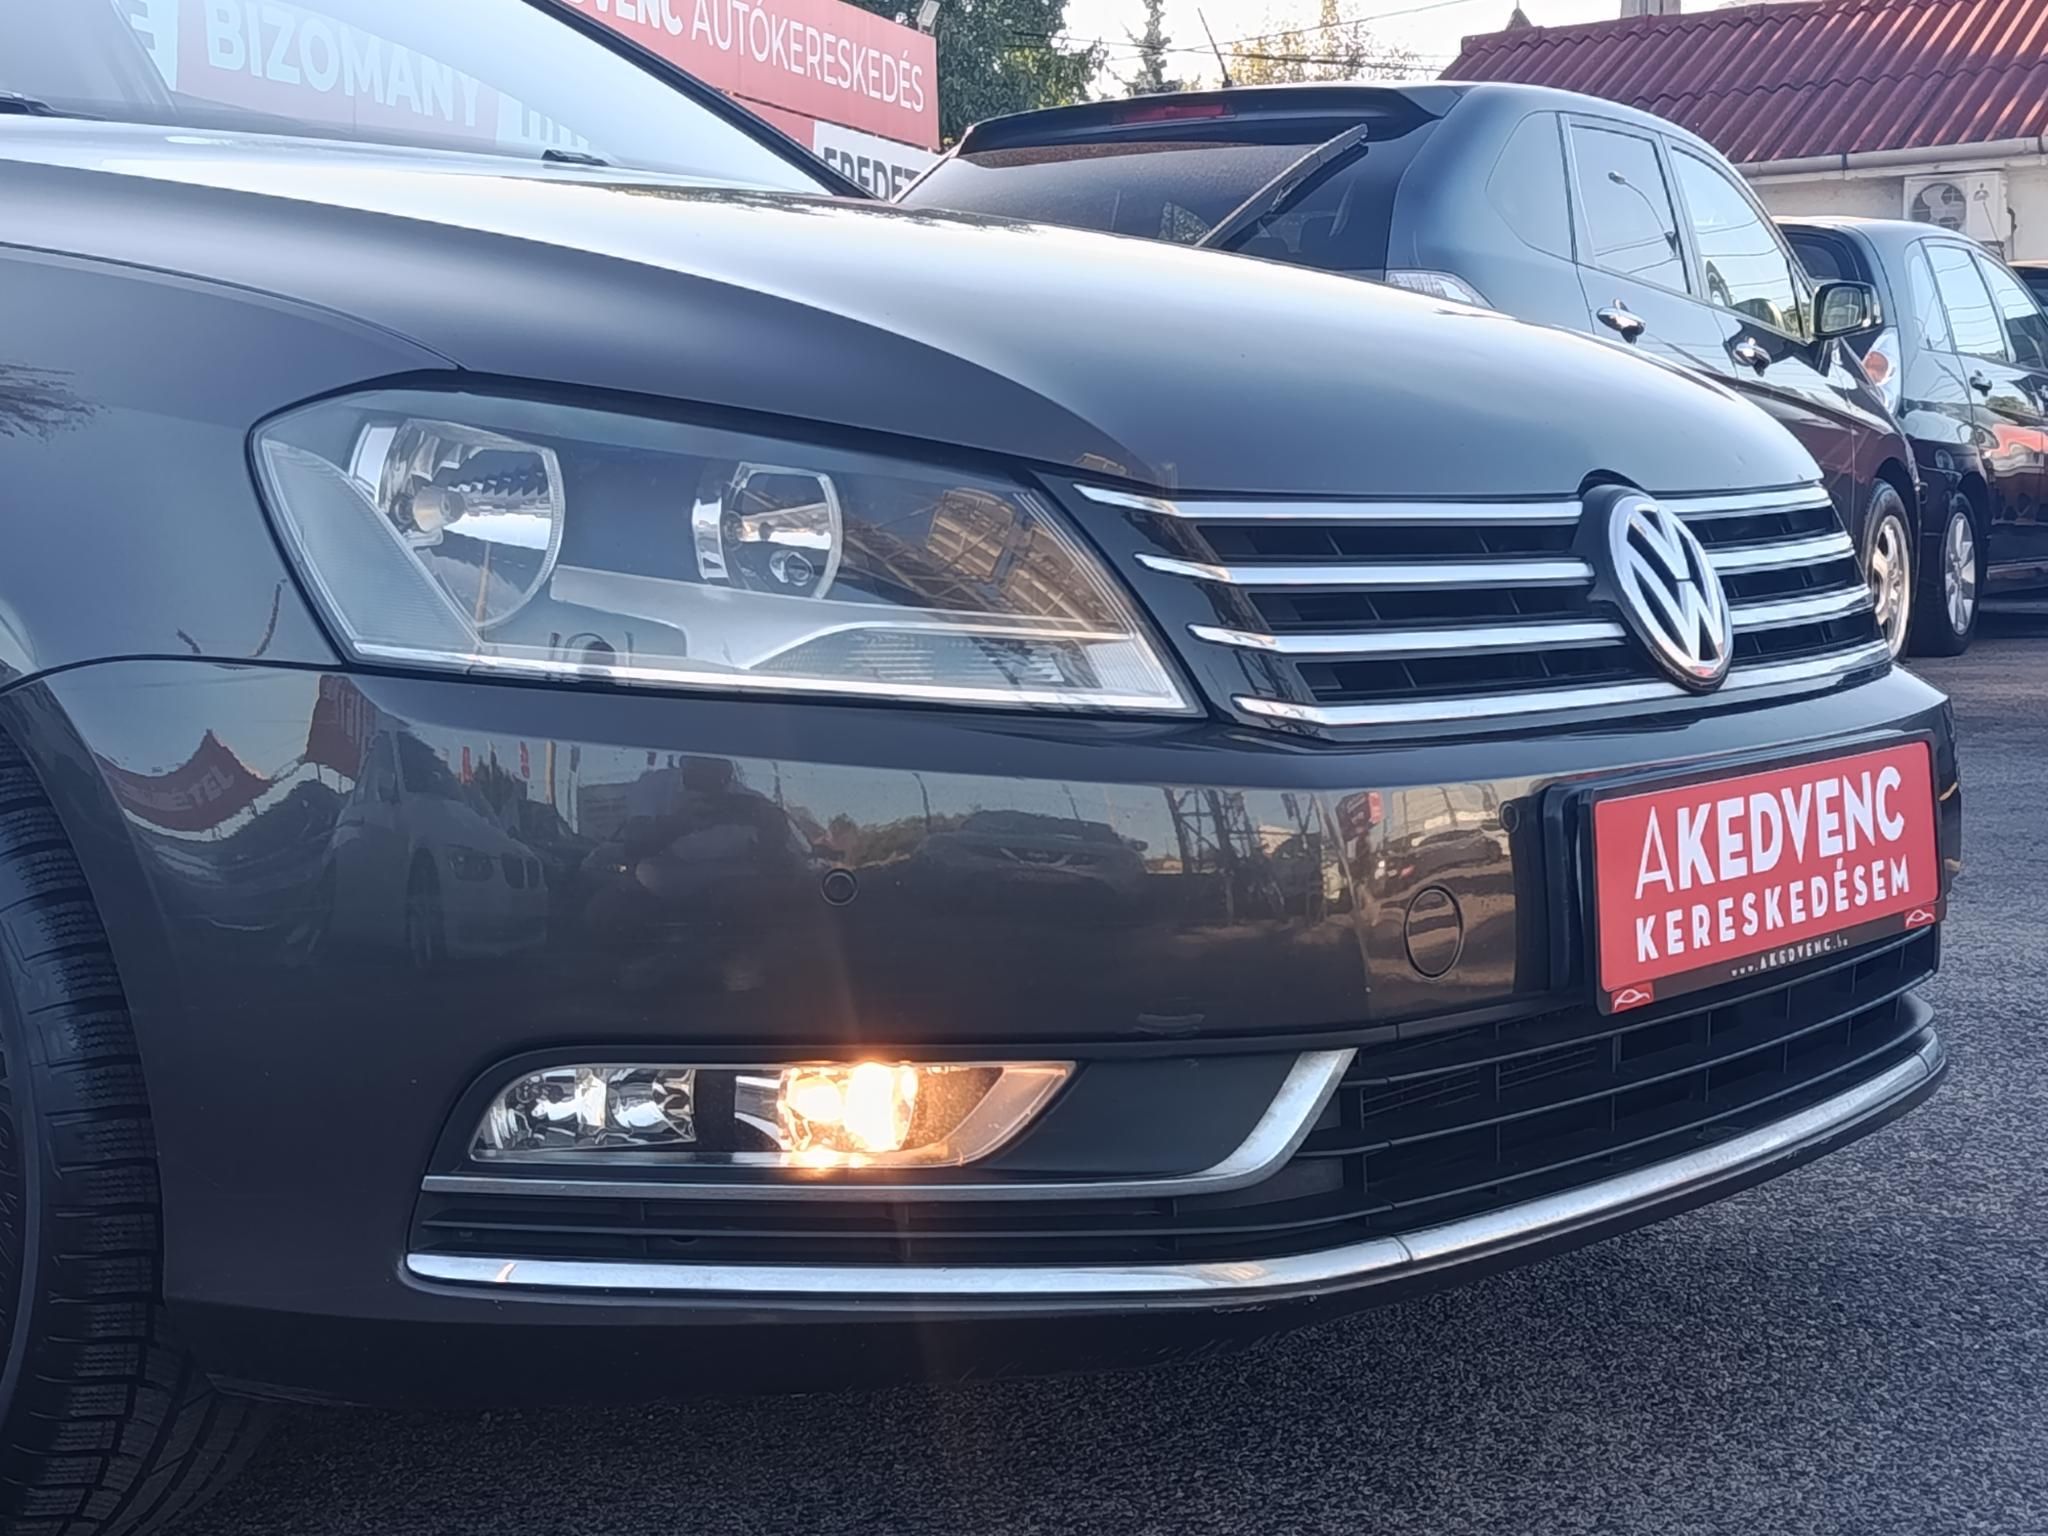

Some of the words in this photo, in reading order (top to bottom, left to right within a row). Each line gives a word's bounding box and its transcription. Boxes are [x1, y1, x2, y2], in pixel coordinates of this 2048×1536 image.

[691, 0, 924, 113] AUTÓKERESKEDÉS
[1633, 765, 1905, 900] AKEDVENC
[1635, 854, 1910, 963] KERESKEDÉSEM
